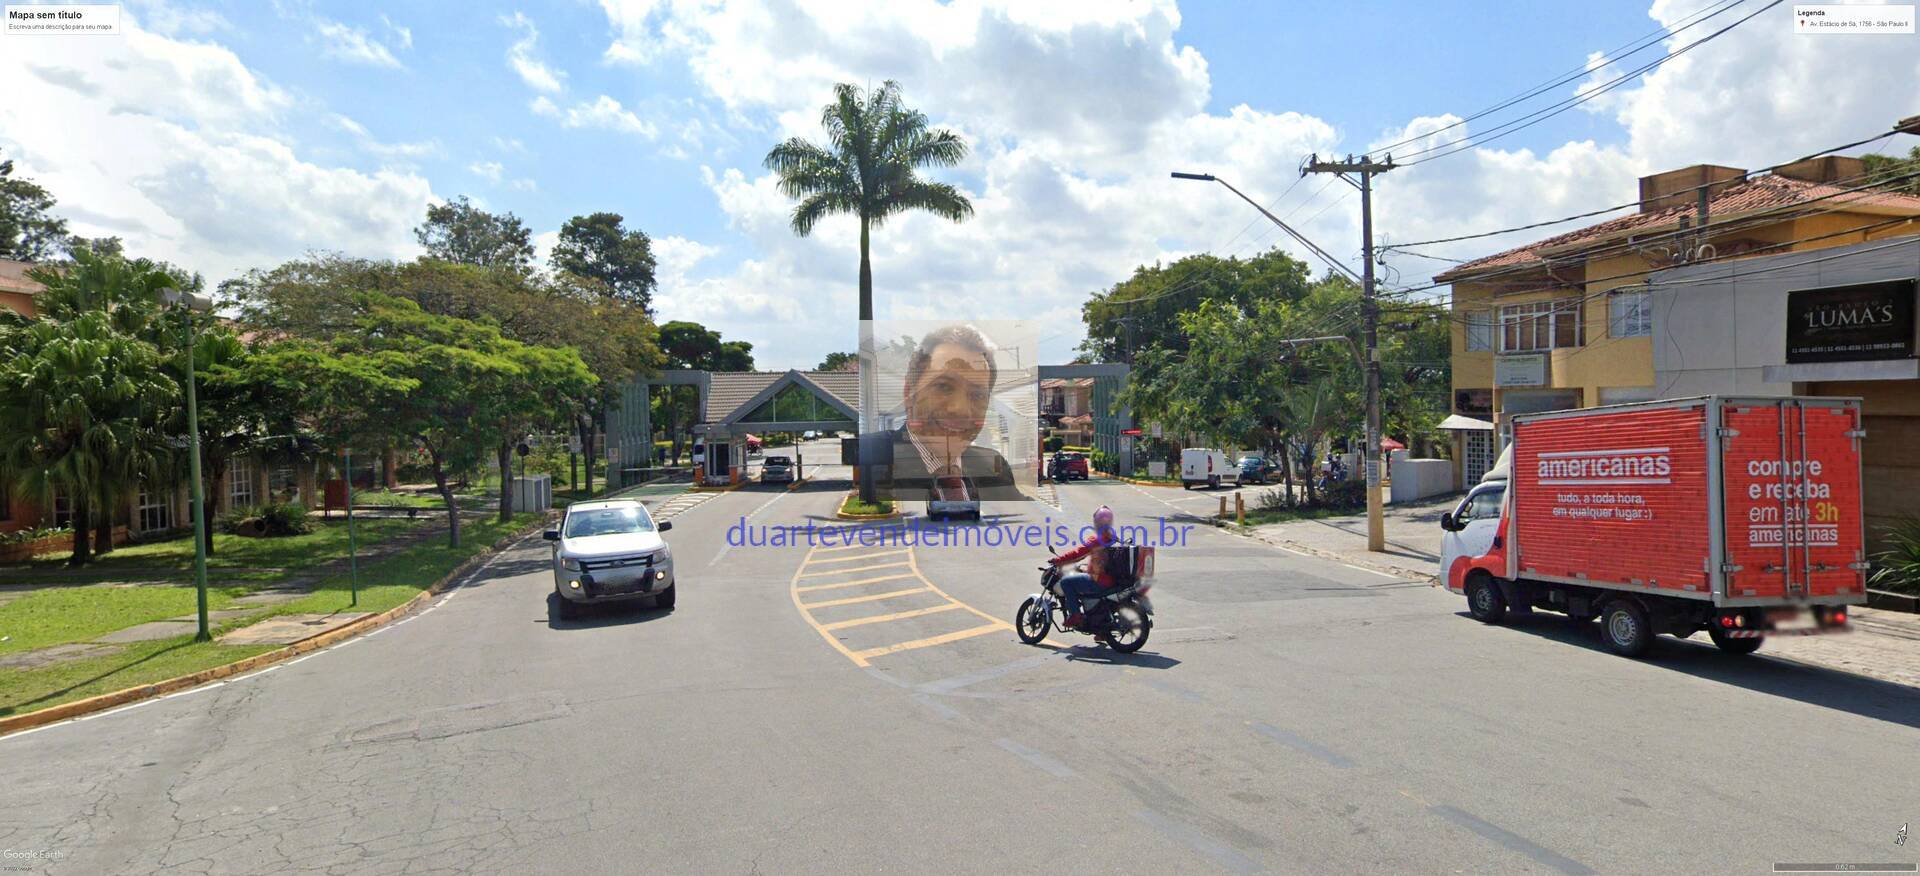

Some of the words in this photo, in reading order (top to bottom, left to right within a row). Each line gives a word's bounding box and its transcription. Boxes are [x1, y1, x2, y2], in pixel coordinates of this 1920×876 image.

[1808, 304, 1893, 328] LUMA'S
[1537, 455, 1671, 478] americanas
[1557, 493, 1582, 505] tudo,
[1592, 493, 1615, 504] toda
[1617, 493, 1645, 505] hora,
[1749, 483, 1761, 499] e
[1766, 480, 1830, 499] receba
[1552, 507, 1567, 516] em
[1569, 507, 1612, 519] qualquer
[1615, 507, 1642, 520] lugar
[1749, 506, 1778, 522] em
[1815, 502, 1839, 522] 3h
[1749, 528, 1838, 543] ameicnas
